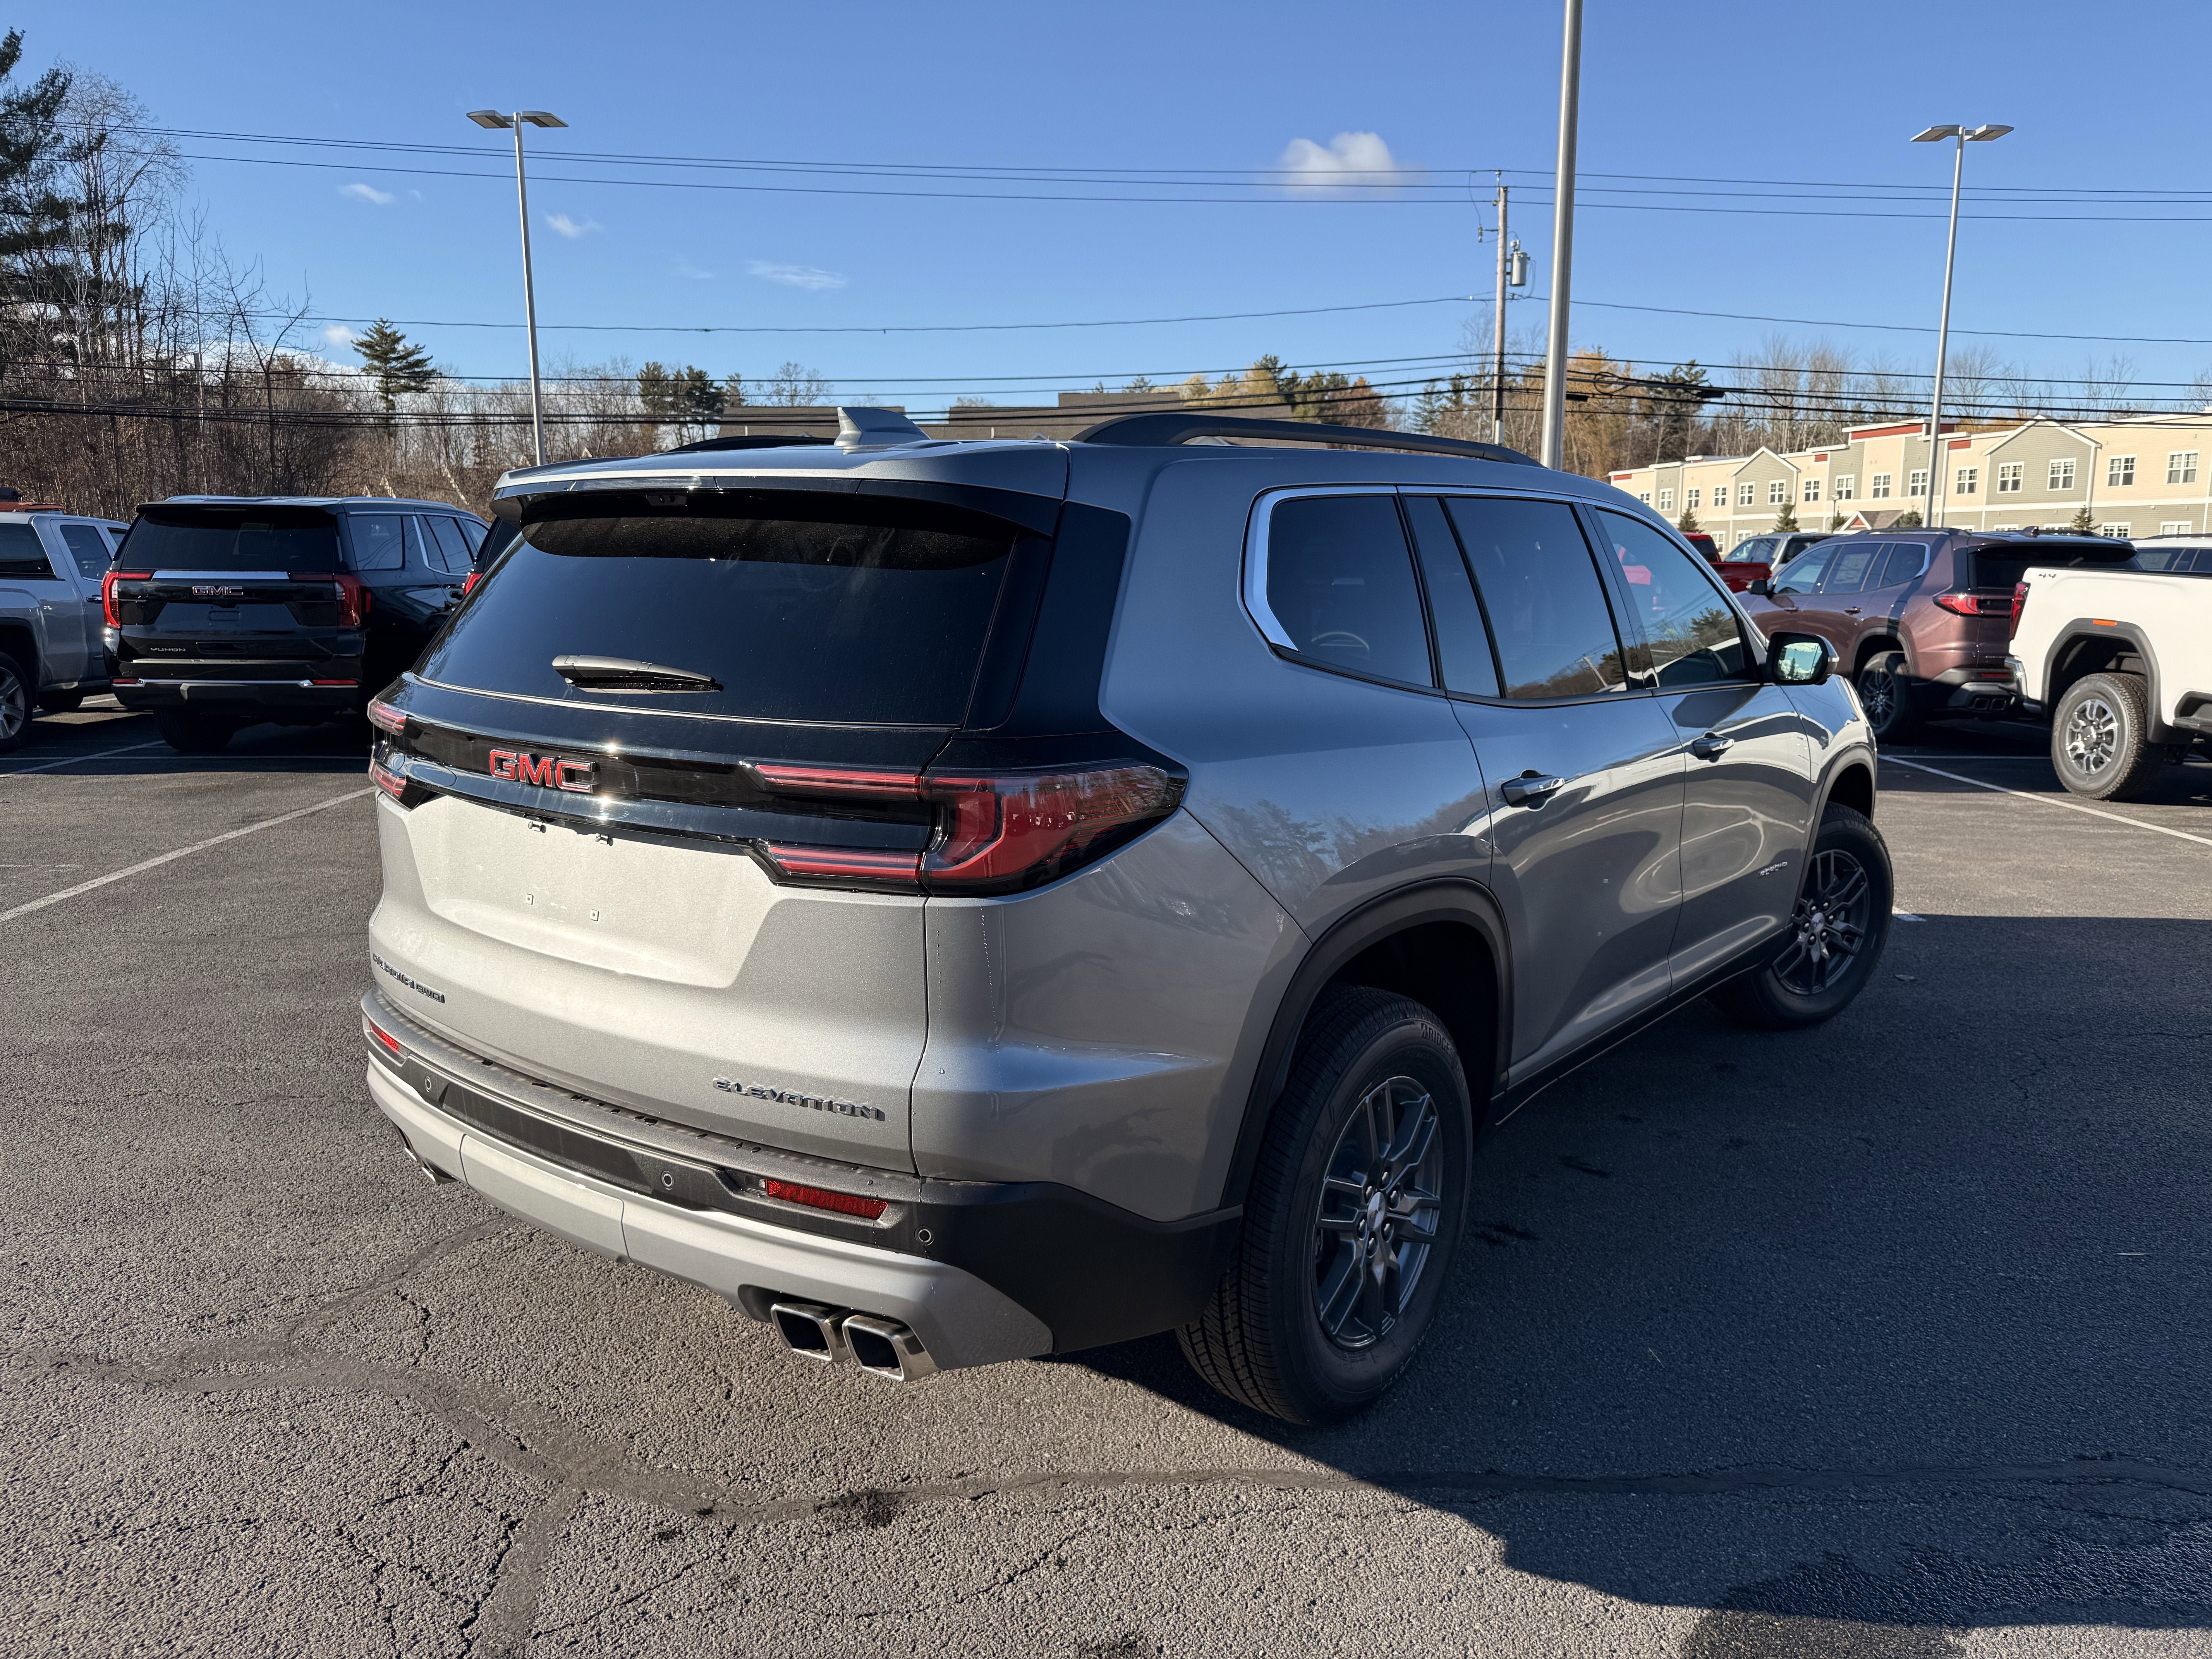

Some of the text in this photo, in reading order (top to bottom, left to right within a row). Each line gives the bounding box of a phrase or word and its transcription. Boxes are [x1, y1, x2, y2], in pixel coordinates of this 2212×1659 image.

[192, 586, 244, 596] GMC
[489, 749, 598, 794] GMC
[713, 1077, 881, 1120] ELEVATION
